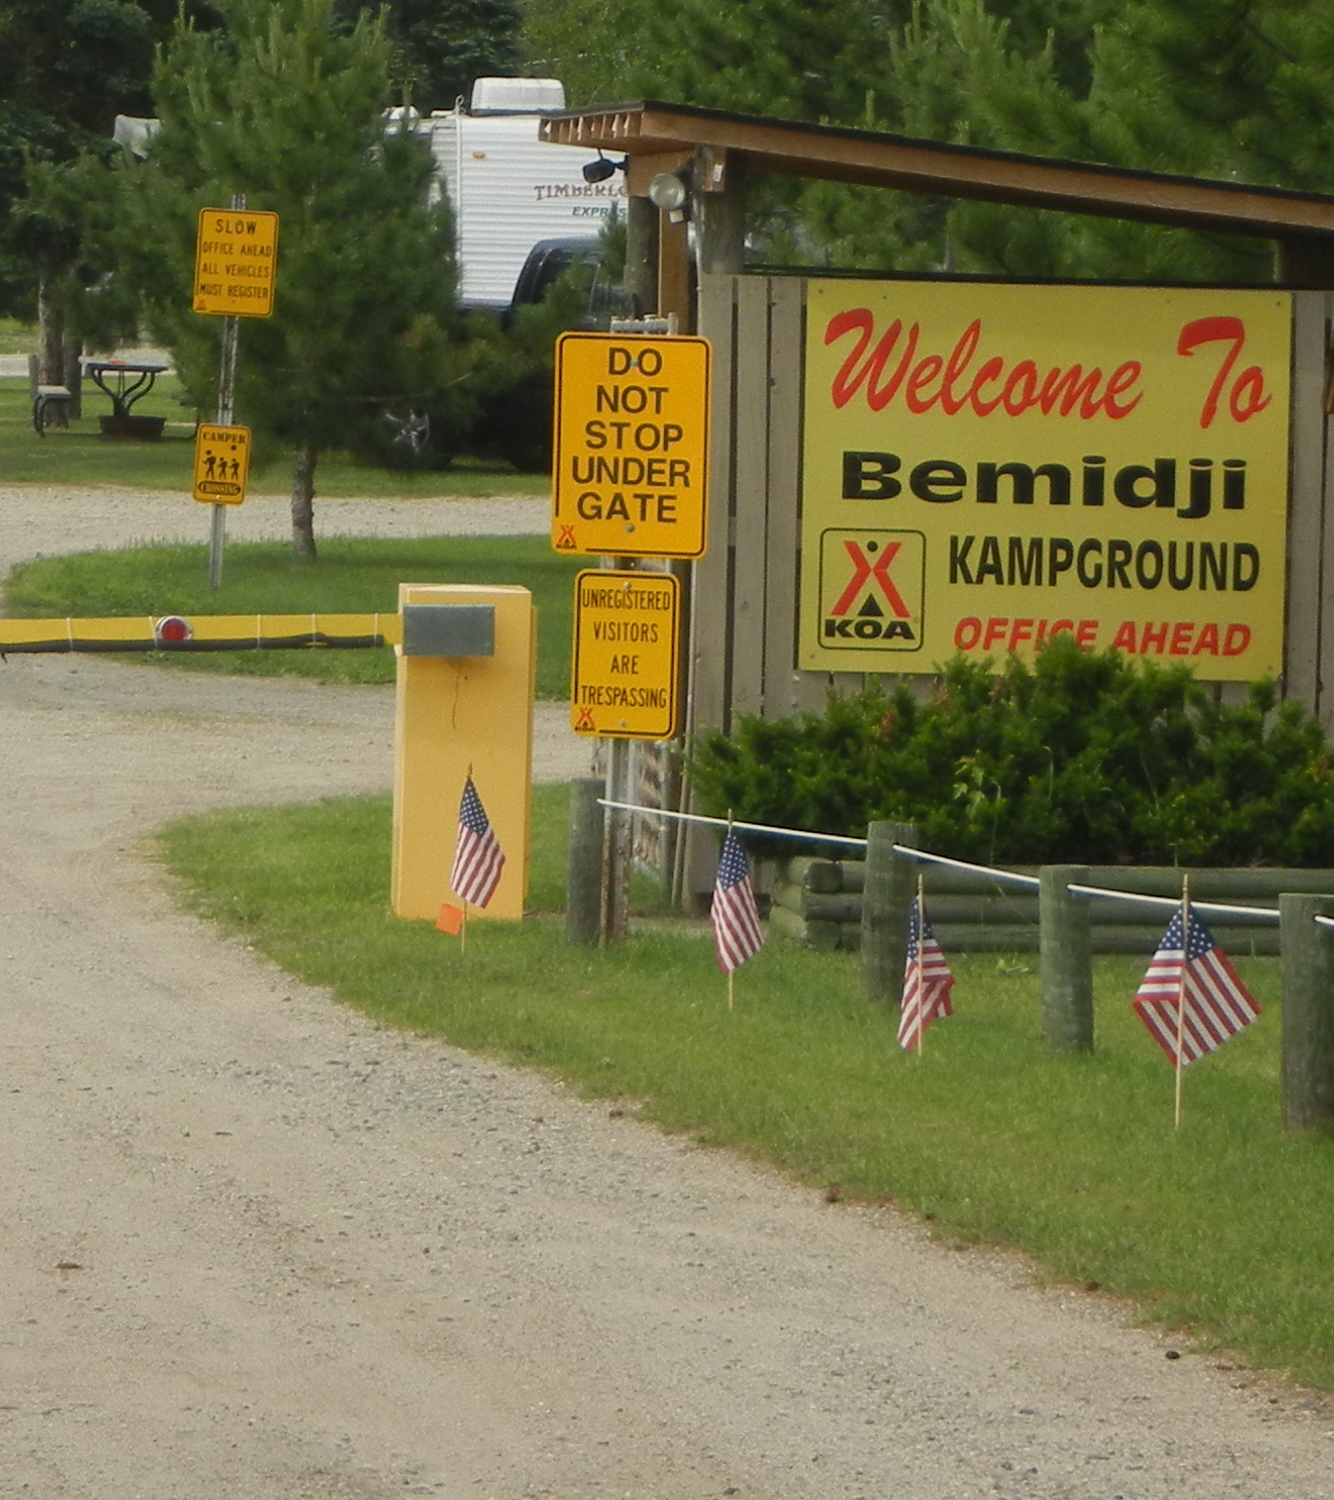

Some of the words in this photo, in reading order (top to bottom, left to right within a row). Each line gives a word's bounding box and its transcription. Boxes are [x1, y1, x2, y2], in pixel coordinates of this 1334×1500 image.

[572, 206, 627, 216] EXPRS
[215, 219, 257, 235] SLOW
[202, 241, 234, 255] OFFICE
[240, 244, 272, 257] AHEAD
[201, 262, 219, 275] ALL
[225, 264, 270, 278] VEHICLES
[199, 283, 223, 296] MUST
[227, 285, 269, 299] REGISTER
[608, 347, 662, 376] DO
[823, 307, 1143, 419] Welcome
[1176, 316, 1272, 430] To
[596, 385, 669, 414] NOT
[203, 431, 246, 443] CAMPER
[585, 420, 683, 451] STOP
[572, 456, 691, 488] UNDER
[842, 451, 1248, 519] Bemidji
[577, 492, 677, 524] GATE
[949, 535, 1260, 592] KAMPGROUND
[582, 588, 670, 611] UNREGISTERED
[593, 621, 659, 643] VISITORS
[824, 619, 915, 640] KOA
[953, 616, 1099, 653] OFFICE
[1112, 620, 1252, 657] AHEAD
[610, 654, 640, 674] ARE
[581, 685, 667, 709] TRESPASSING
